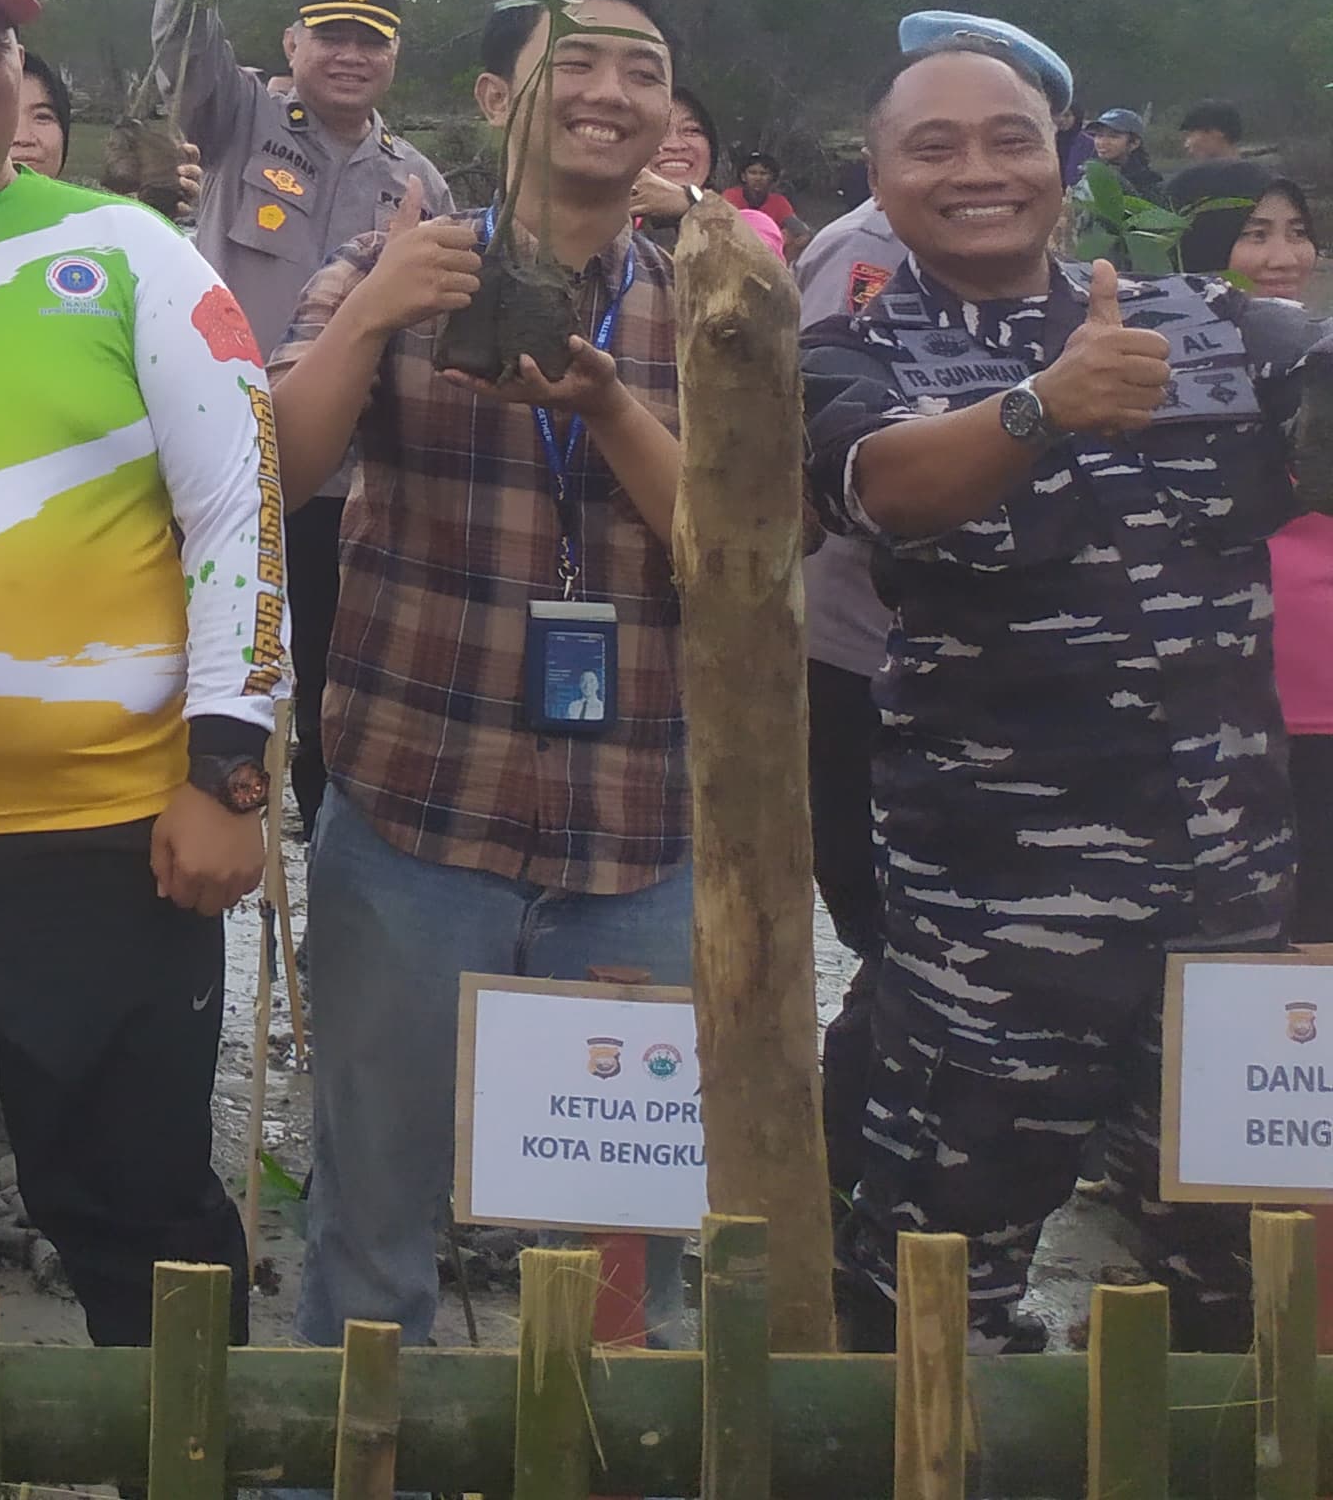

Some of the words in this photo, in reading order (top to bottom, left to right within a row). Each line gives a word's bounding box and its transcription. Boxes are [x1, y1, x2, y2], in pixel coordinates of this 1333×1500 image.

[1246, 1064, 1333, 1093] DANL
[549, 1094, 637, 1122] KETUA
[1245, 1118, 1333, 1148] BENG
[521, 1135, 591, 1162] KOTA
[599, 1140, 706, 1167] BENGKU
